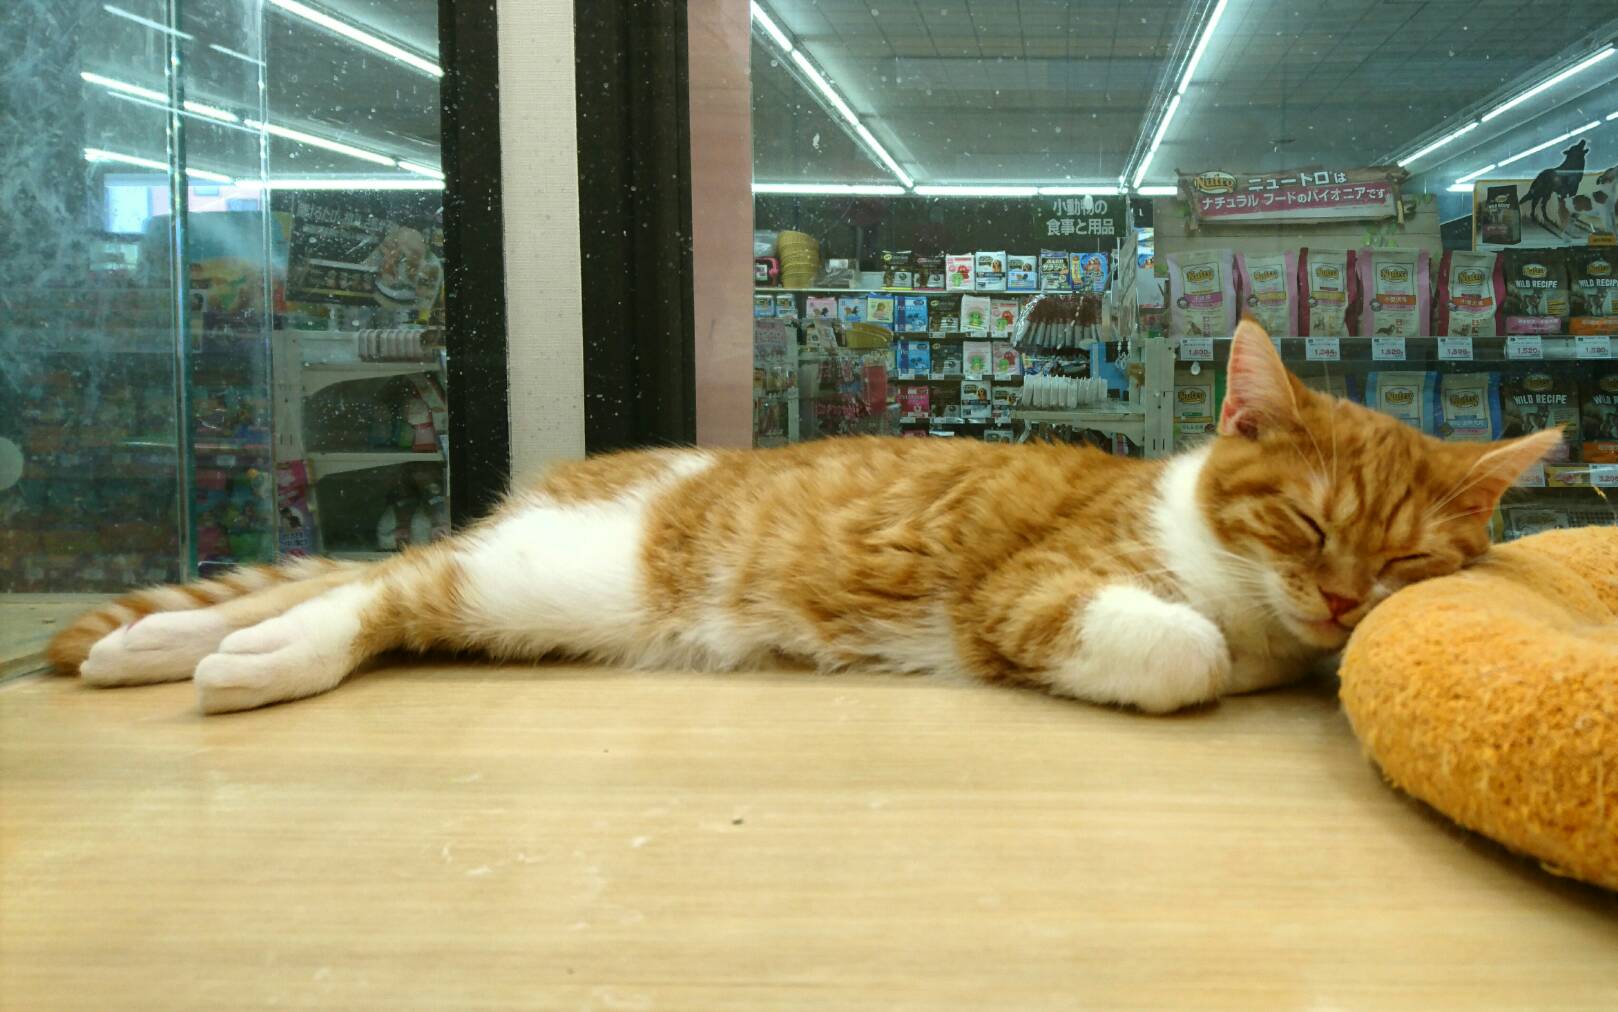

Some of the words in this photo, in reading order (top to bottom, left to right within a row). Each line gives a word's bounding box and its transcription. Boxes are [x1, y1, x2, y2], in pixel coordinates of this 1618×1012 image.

[1248, 171, 1347, 192] ニュートロは
[1046, 218, 1115, 236] 食事と用品
[1532, 280, 1558, 289] RECIPE
[1535, 394, 1568, 405] RECIPE
